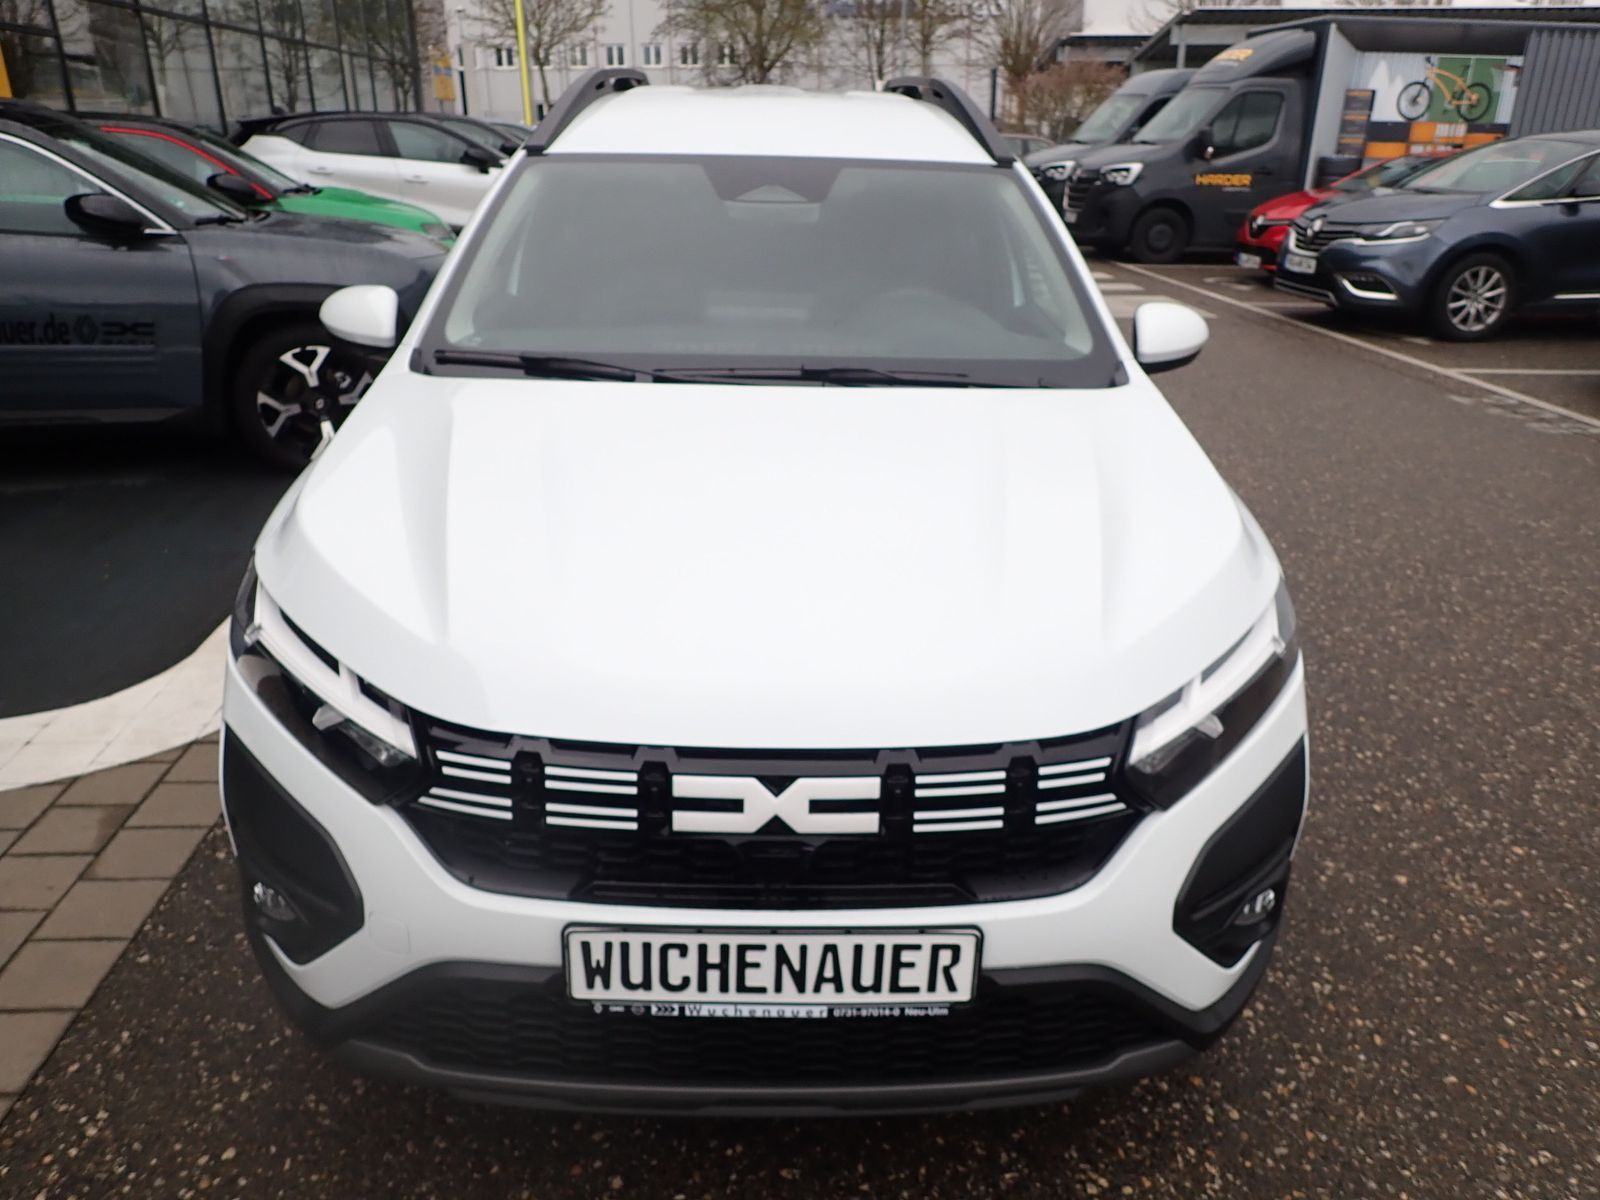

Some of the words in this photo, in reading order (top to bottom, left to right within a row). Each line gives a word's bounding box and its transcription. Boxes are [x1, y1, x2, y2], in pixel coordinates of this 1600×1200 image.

[1195, 173, 1252, 187] HARDER
[0, 312, 71, 344] uer.de
[580, 940, 962, 994] WUCHENAUER
[686, 1004, 826, 1018] Wuchenauer
